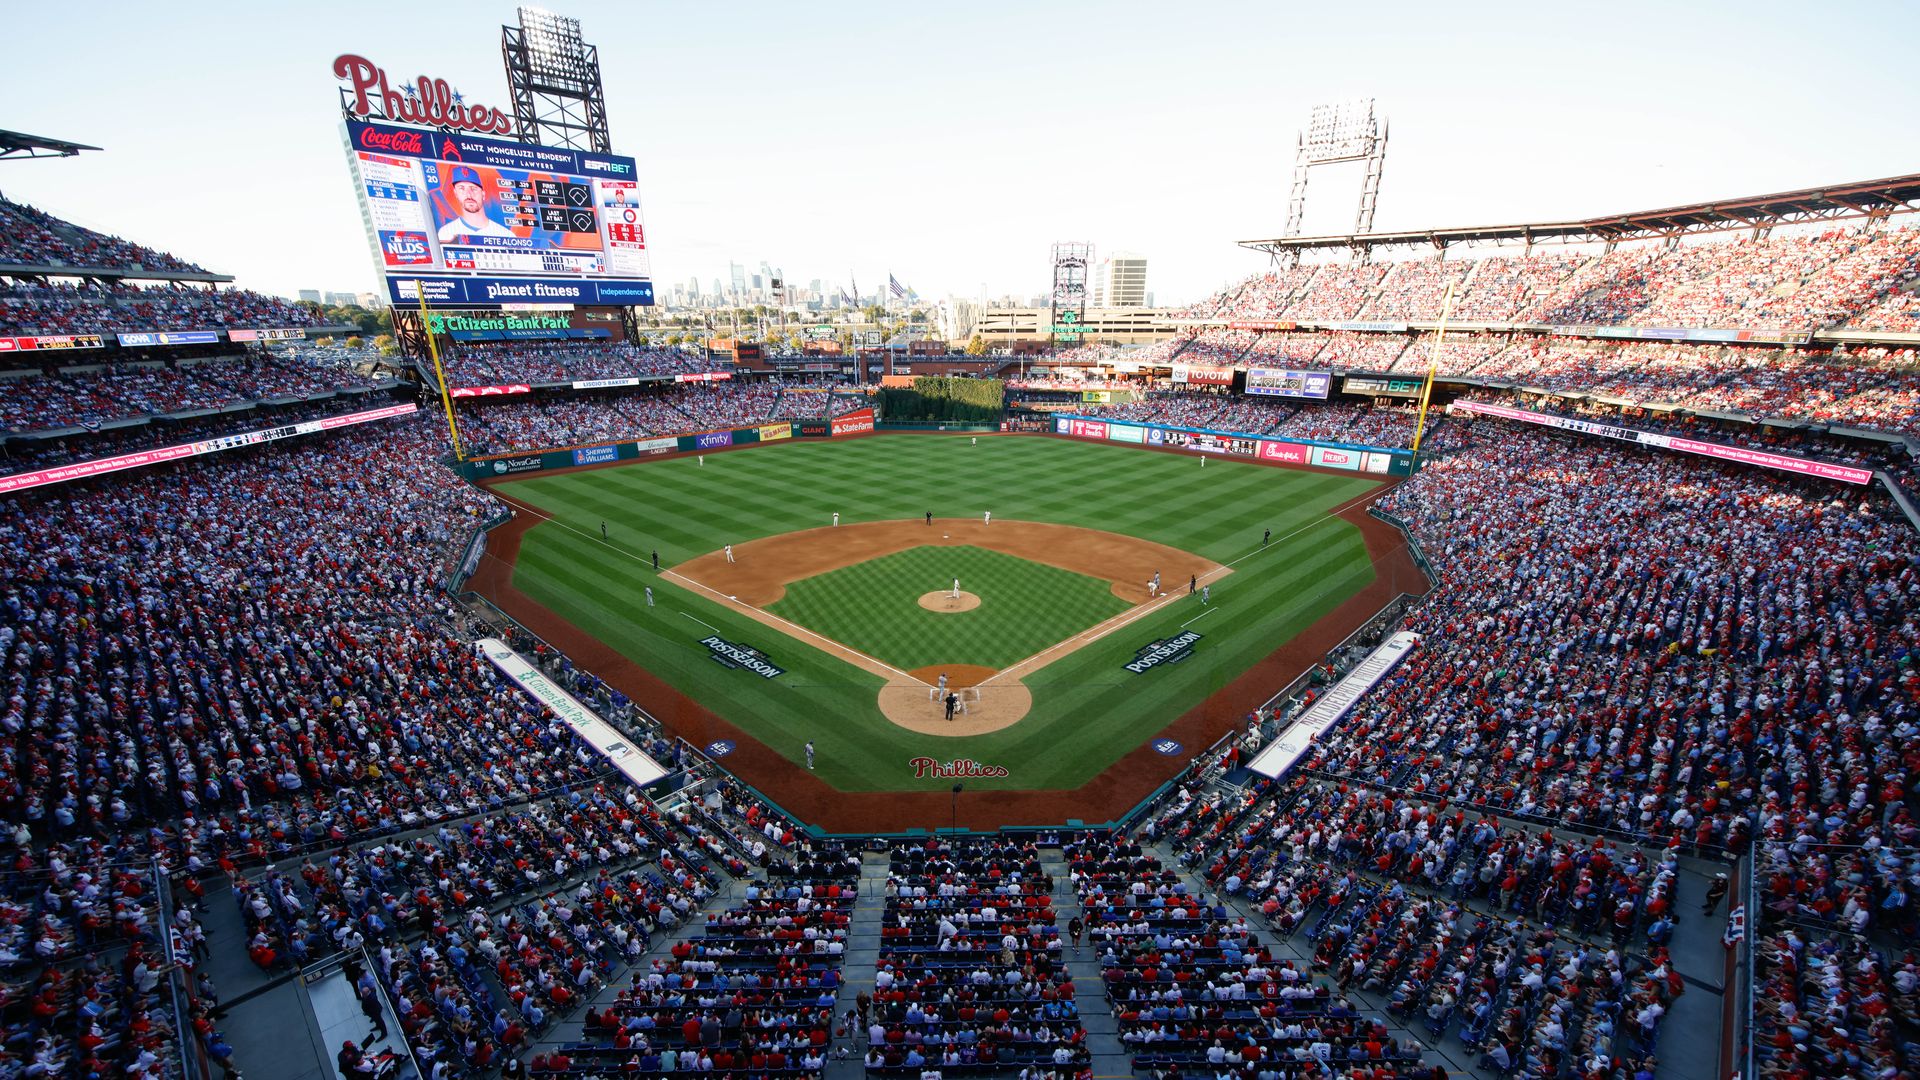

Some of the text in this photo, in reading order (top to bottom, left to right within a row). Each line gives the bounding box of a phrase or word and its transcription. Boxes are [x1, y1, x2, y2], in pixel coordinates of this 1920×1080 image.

[334, 54, 511, 134] Phillies
[361, 127, 422, 153] Coca-Cola
[461, 142, 571, 163] SALTZ MONGELUZZI BENDESKY
[486, 156, 554, 170] INJURY LAWYERS
[584, 159, 631, 174] ESPN BET
[427, 175, 438, 184] 20
[387, 242, 425, 254] NLDS
[502, 238, 532, 247] ALONSO
[487, 283, 580, 298] planet fitness
[600, 288, 644, 297] Independence
[447, 316, 571, 331] Citizens Bank Park
[123, 334, 150, 345] GOYA
[1190, 370, 1229, 381] TOYOTA
[1347, 379, 1422, 392] ESPN BET
[701, 434, 728, 447] xfinity
[1676, 440, 1691, 448] Temple
[1692, 443, 1707, 451] Health
[158, 450, 175, 459] Temple
[175, 447, 192, 456] Health
[586, 447, 612, 455] SHERWIN
[1325, 453, 1346, 462] HERR'S
[508, 458, 541, 468] NovaCare
[1712, 447, 1726, 455] Temple
[1783, 459, 1792, 467] Live
[1793, 460, 1808, 469] Better
[47, 470, 65, 480] Temple
[65, 469, 78, 477] Lung
[126, 457, 135, 465] Live
[135, 455, 148, 463] Better
[1821, 466, 1843, 476] Temple
[1844, 469, 1866, 480] Health
[18, 475, 40, 485] Health
[700, 637, 780, 678] POSTSEASON
[1126, 632, 1201, 673] POSTSEASON
[1301, 656, 1391, 729] PHILADELPHIA PHILLIES
[529, 680, 592, 727] Citizens Bank Park
[909, 757, 1009, 778] Phillies
[1321, 1050, 1327, 1058] 5
